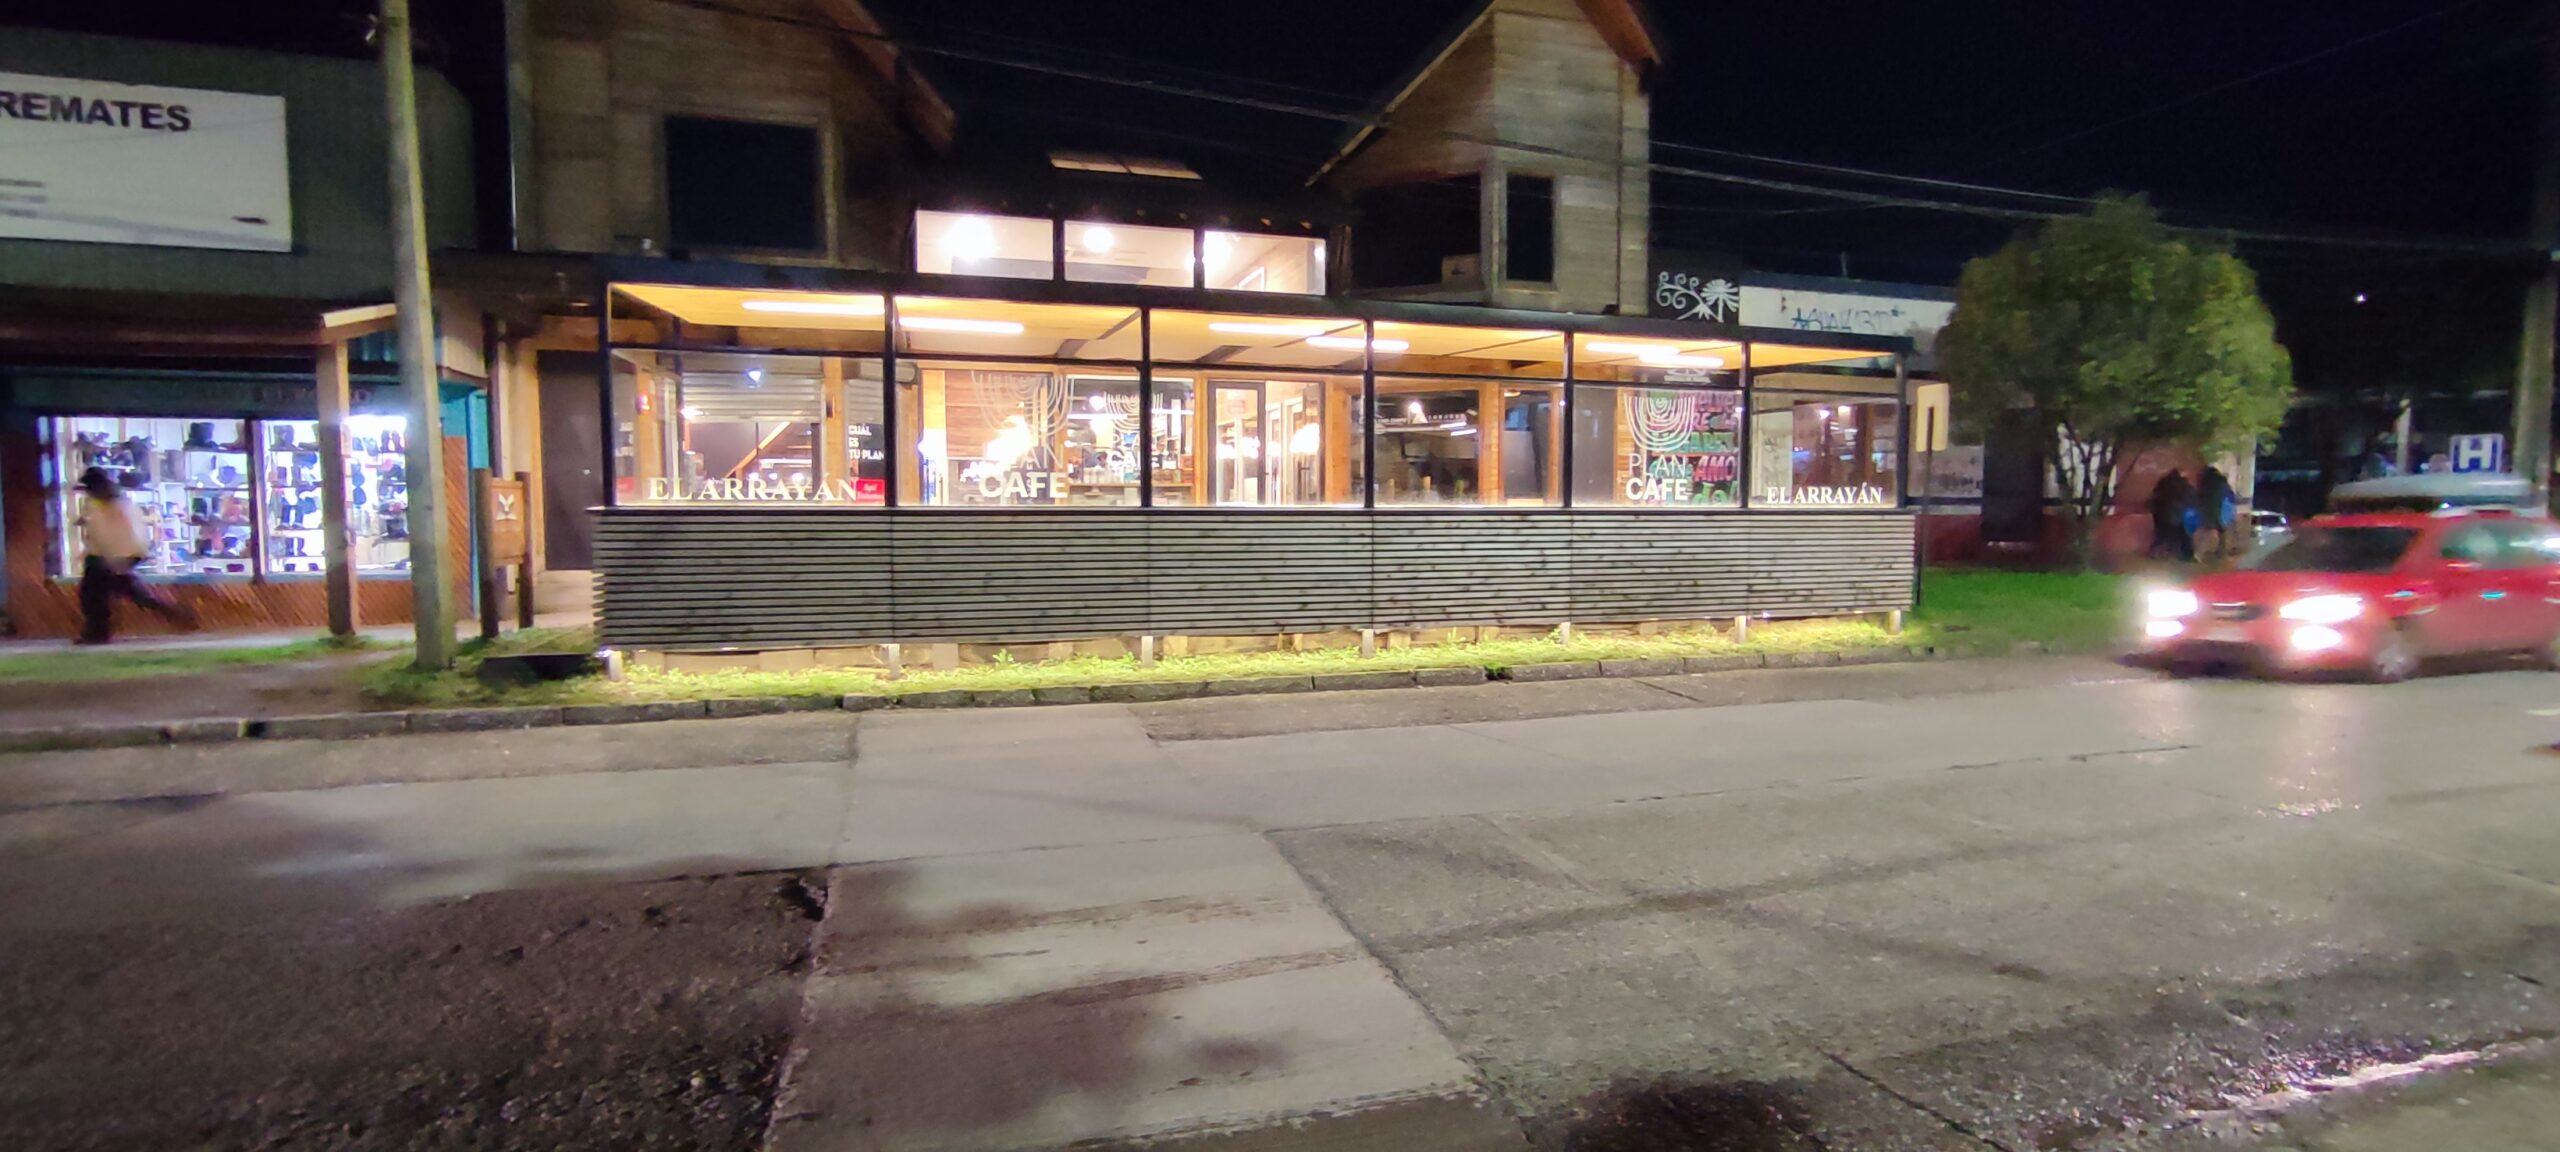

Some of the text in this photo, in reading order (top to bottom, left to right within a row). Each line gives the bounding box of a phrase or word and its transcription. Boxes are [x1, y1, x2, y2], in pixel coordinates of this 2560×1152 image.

[1628, 453, 1687, 477] PLAN
[2459, 437, 2492, 469] H
[648, 477, 692, 501] EL
[698, 472, 858, 501] ARRAYÁN
[979, 472, 1068, 498] CAFE
[1626, 478, 1688, 501] CAFE
[1766, 482, 1883, 504] EL ARRAYÁN
